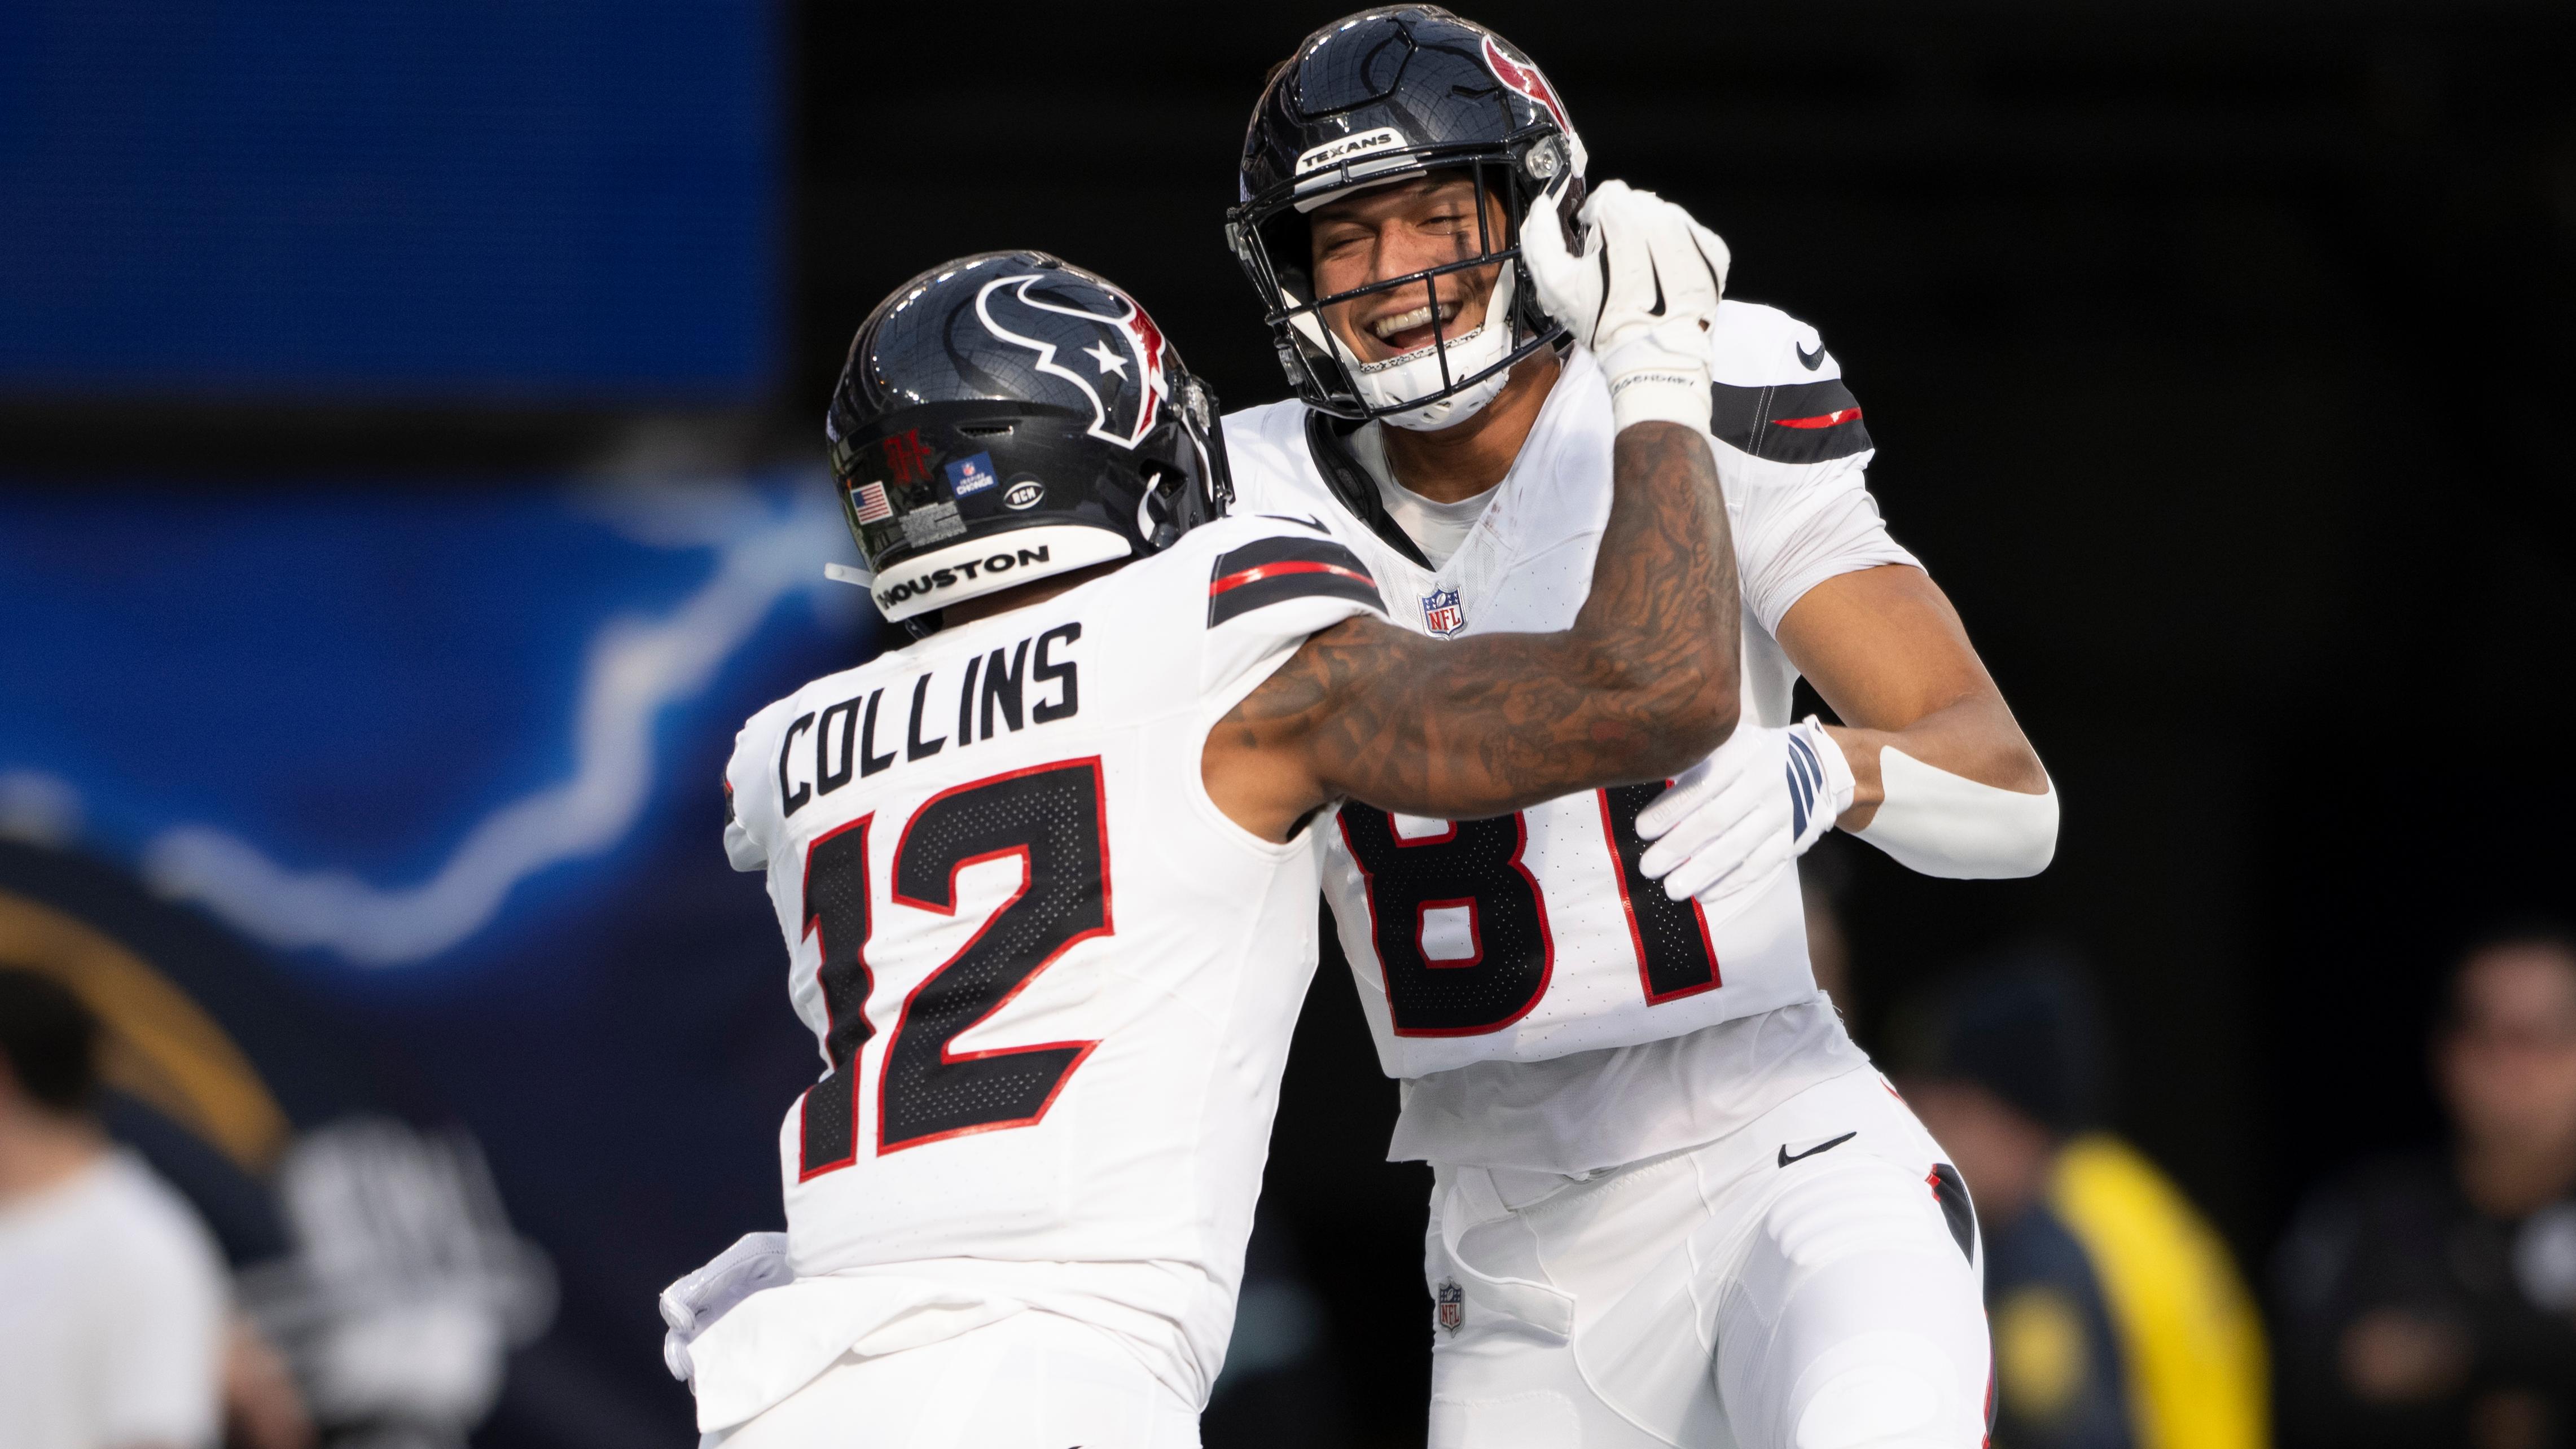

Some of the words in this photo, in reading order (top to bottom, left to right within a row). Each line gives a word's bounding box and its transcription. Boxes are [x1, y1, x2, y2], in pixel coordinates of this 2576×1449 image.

[1302, 134, 1392, 167] TEXANS
[876, 545, 1050, 610] HOUSTON
[1428, 608, 1461, 631] NFL
[779, 622, 1081, 818] COLLINS
[1336, 778, 1722, 1038] 81
[799, 754, 1115, 1183] 12
[1441, 1303, 1460, 1326] NFL
